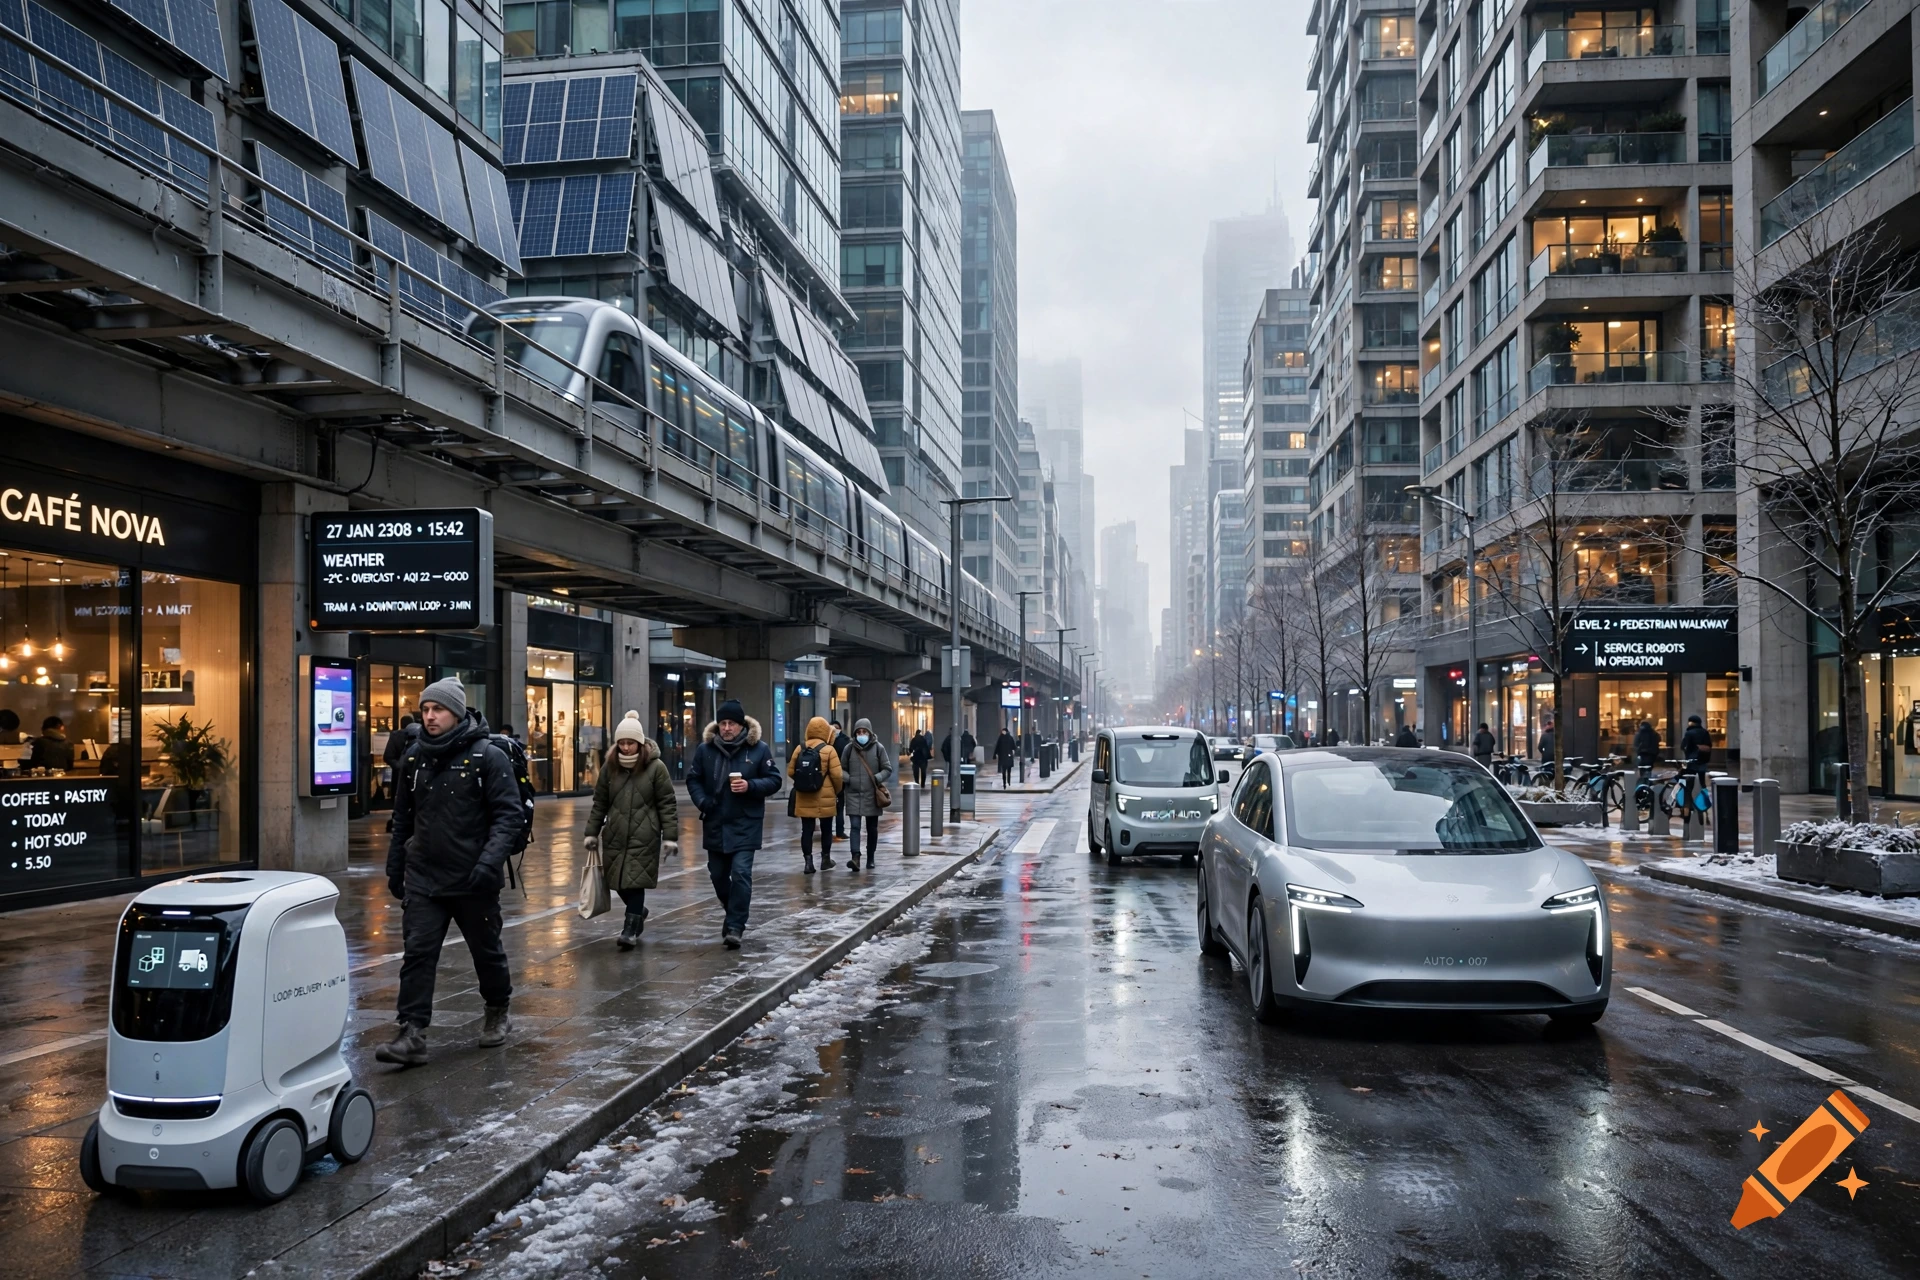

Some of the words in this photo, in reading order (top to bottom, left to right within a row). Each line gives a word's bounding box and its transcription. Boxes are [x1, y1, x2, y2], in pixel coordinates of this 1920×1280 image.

[0, 488, 82, 532] CAFÉ
[91, 505, 165, 546] NOVA
[326, 524, 343, 539] 27
[346, 523, 374, 538] JAN
[377, 522, 412, 538] 2308
[428, 521, 464, 536] 15:42
[323, 553, 385, 567] WEATHER
[351, 572, 395, 584] OVERCAST
[403, 571, 418, 583] AQI
[420, 571, 430, 582] 22
[323, 601, 348, 612] TRAM
[350, 602, 357, 612] A
[420, 600, 441, 611] LOOP
[449, 600, 455, 611] 3
[456, 600, 471, 611] MIN
[1574, 619, 1602, 630] LEVEL
[1604, 619, 1611, 630] 2
[1620, 618, 1678, 630] PEDESTRIAN
[1679, 618, 1729, 630] WALKWAY
[1604, 643, 1644, 654] SERVICE
[1645, 643, 1686, 654] ROBOTS
[1595, 656, 1607, 667] IN
[1608, 656, 1664, 667] OPERATION
[1, 791, 50, 807] COFFEE
[64, 789, 107, 803] PASTRY
[24, 812, 67, 828] TODAY
[24, 834, 52, 850] HOT
[54, 831, 87, 847] SOUP
[25, 855, 52, 870] 5.50
[1423, 956, 1454, 966] AUTO
[1468, 956, 1488, 966] 007
